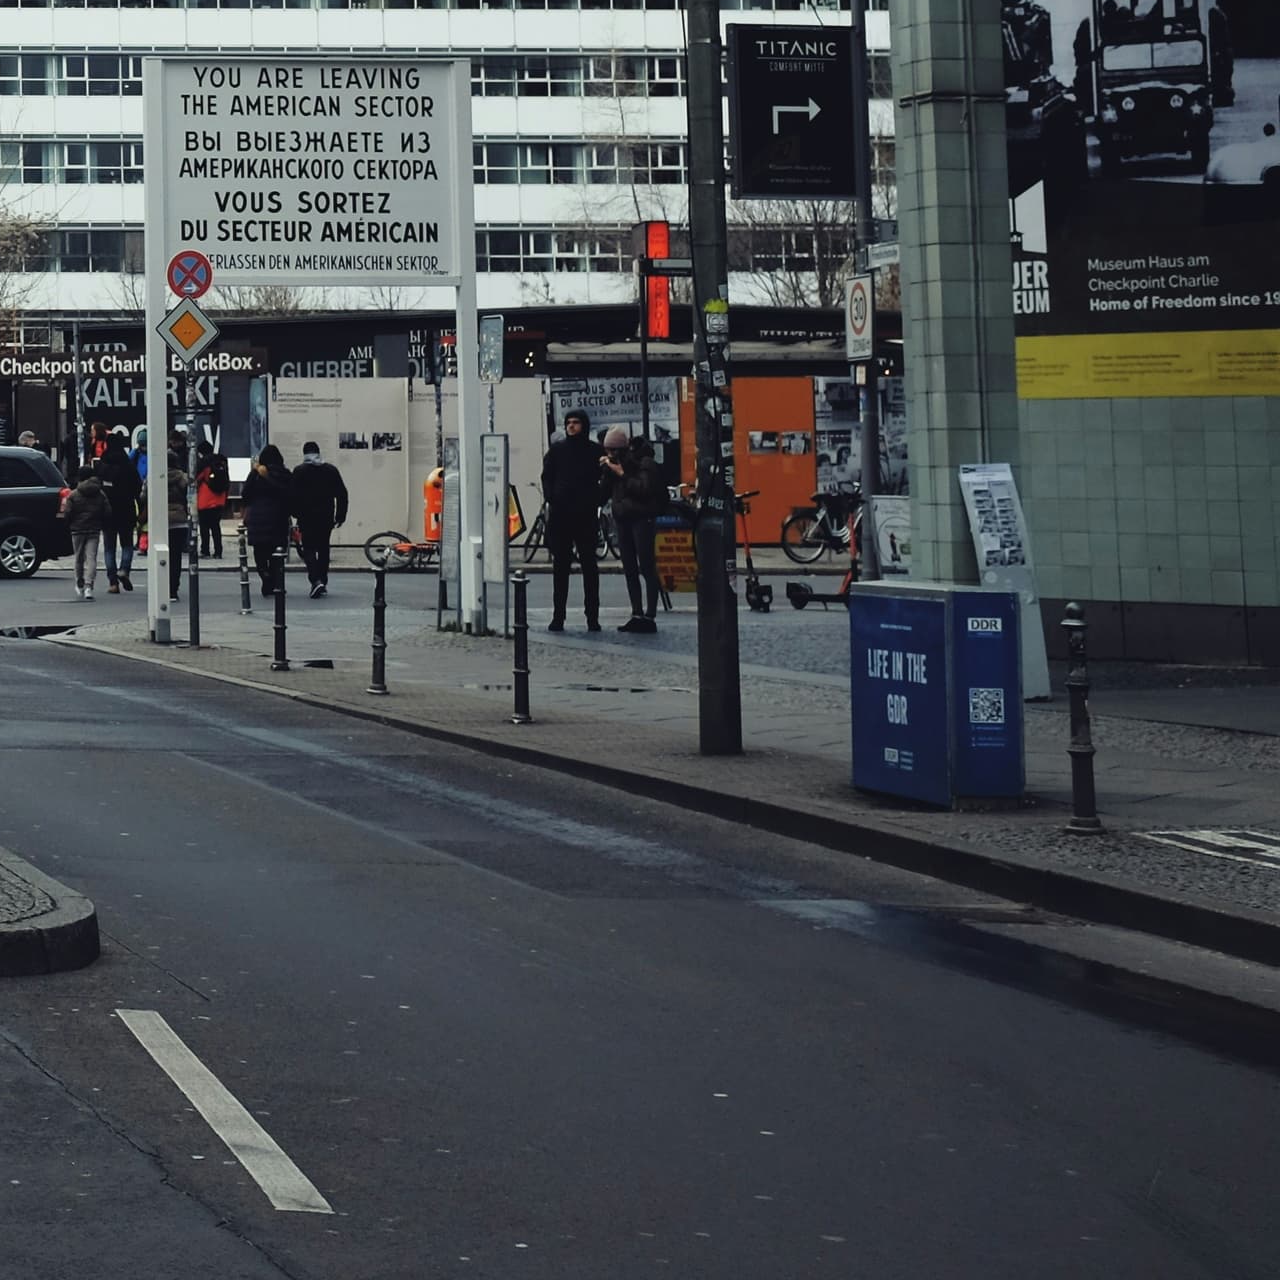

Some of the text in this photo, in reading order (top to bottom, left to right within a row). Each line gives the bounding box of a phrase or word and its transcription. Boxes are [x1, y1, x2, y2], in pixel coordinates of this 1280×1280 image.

[755, 40, 838, 56] TITANIC
[193, 66, 421, 90] YOU ARE LEAVING
[769, 61, 825, 73] COMFORT MITTE
[181, 94, 434, 118] THE AMERICAN SECTOR
[185, 131, 431, 154] ВЫ ВЫЕЗЖАЕТЕ ИЗ
[179, 158, 439, 181] АМЕРИКАНСКОГО СЕКТОРА
[215, 191, 391, 214] VOUS SORTEZ
[181, 217, 439, 243] DU SECTEUR AMÉRICAIN
[269, 254, 290, 269] DEN
[295, 254, 393, 270] AMERIKANISCHEN
[396, 255, 439, 271] SEKTOR
[1088, 255, 1210, 271] Museum Haus am
[1088, 274, 1220, 293] Checkpoint Charlie
[853, 296, 864, 321] 30
[1090, 297, 1130, 311] Home
[1133, 296, 1149, 309] of
[1152, 294, 1216, 309] Freedom
[1220, 292, 1261, 307] since
[0, 357, 95, 378] Checkpoint
[578, 395, 615, 407] SECTEUR
[971, 618, 999, 630] DDR
[867, 648, 928, 684] LIFE IN THE
[887, 693, 909, 726] GDR
